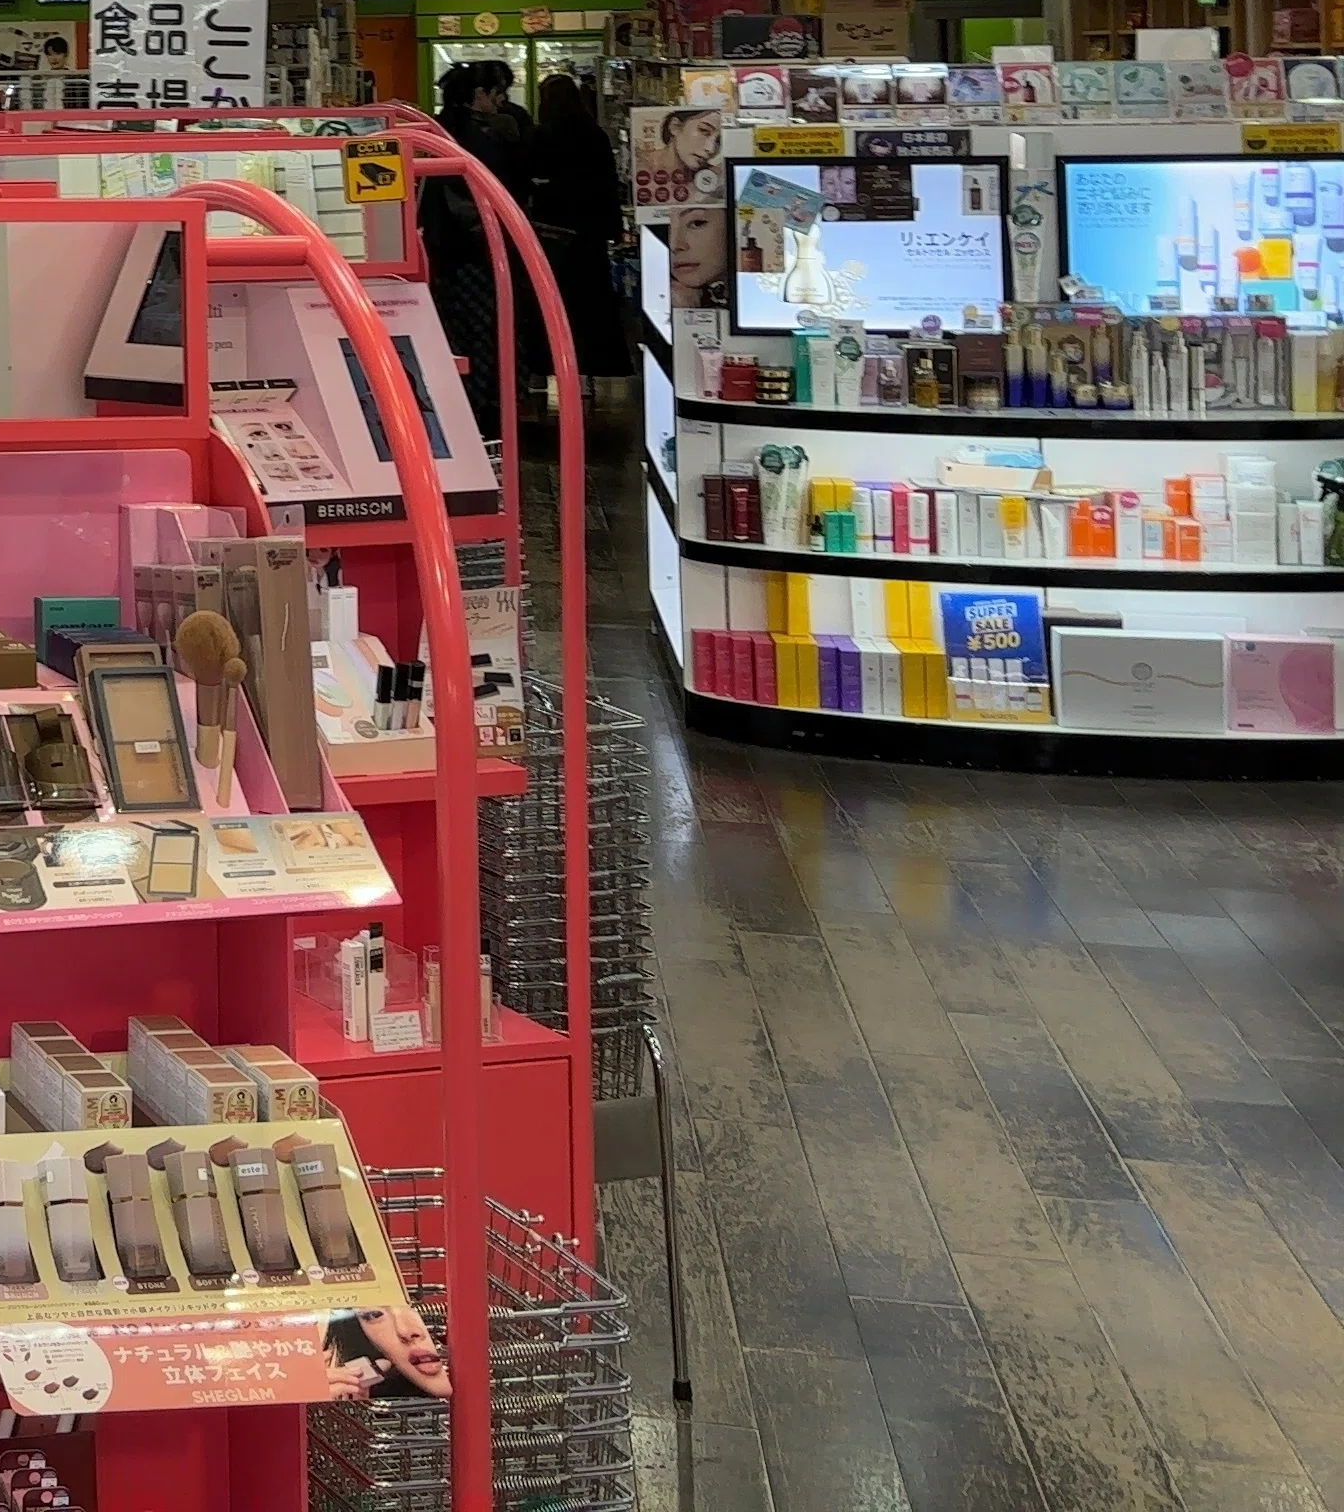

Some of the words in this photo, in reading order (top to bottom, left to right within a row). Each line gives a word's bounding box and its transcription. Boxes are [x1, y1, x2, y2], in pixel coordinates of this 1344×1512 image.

[94, 1, 187, 56] 食品
[357, 142, 388, 153] CCTV
[317, 501, 394, 519] BERRISOM
[968, 605, 1015, 619] SUPER
[975, 618, 1010, 631] SALE
[967, 631, 1022, 651] ¥500
[195, 1278, 219, 1287] SOFT
[270, 1274, 292, 1283] CLAY
[334, 1273, 362, 1282] LATTE
[136, 1282, 165, 1290] STONE
[164, 1360, 288, 1386] 立体フェイス
[192, 1388, 276, 1404] SHEGLAM
